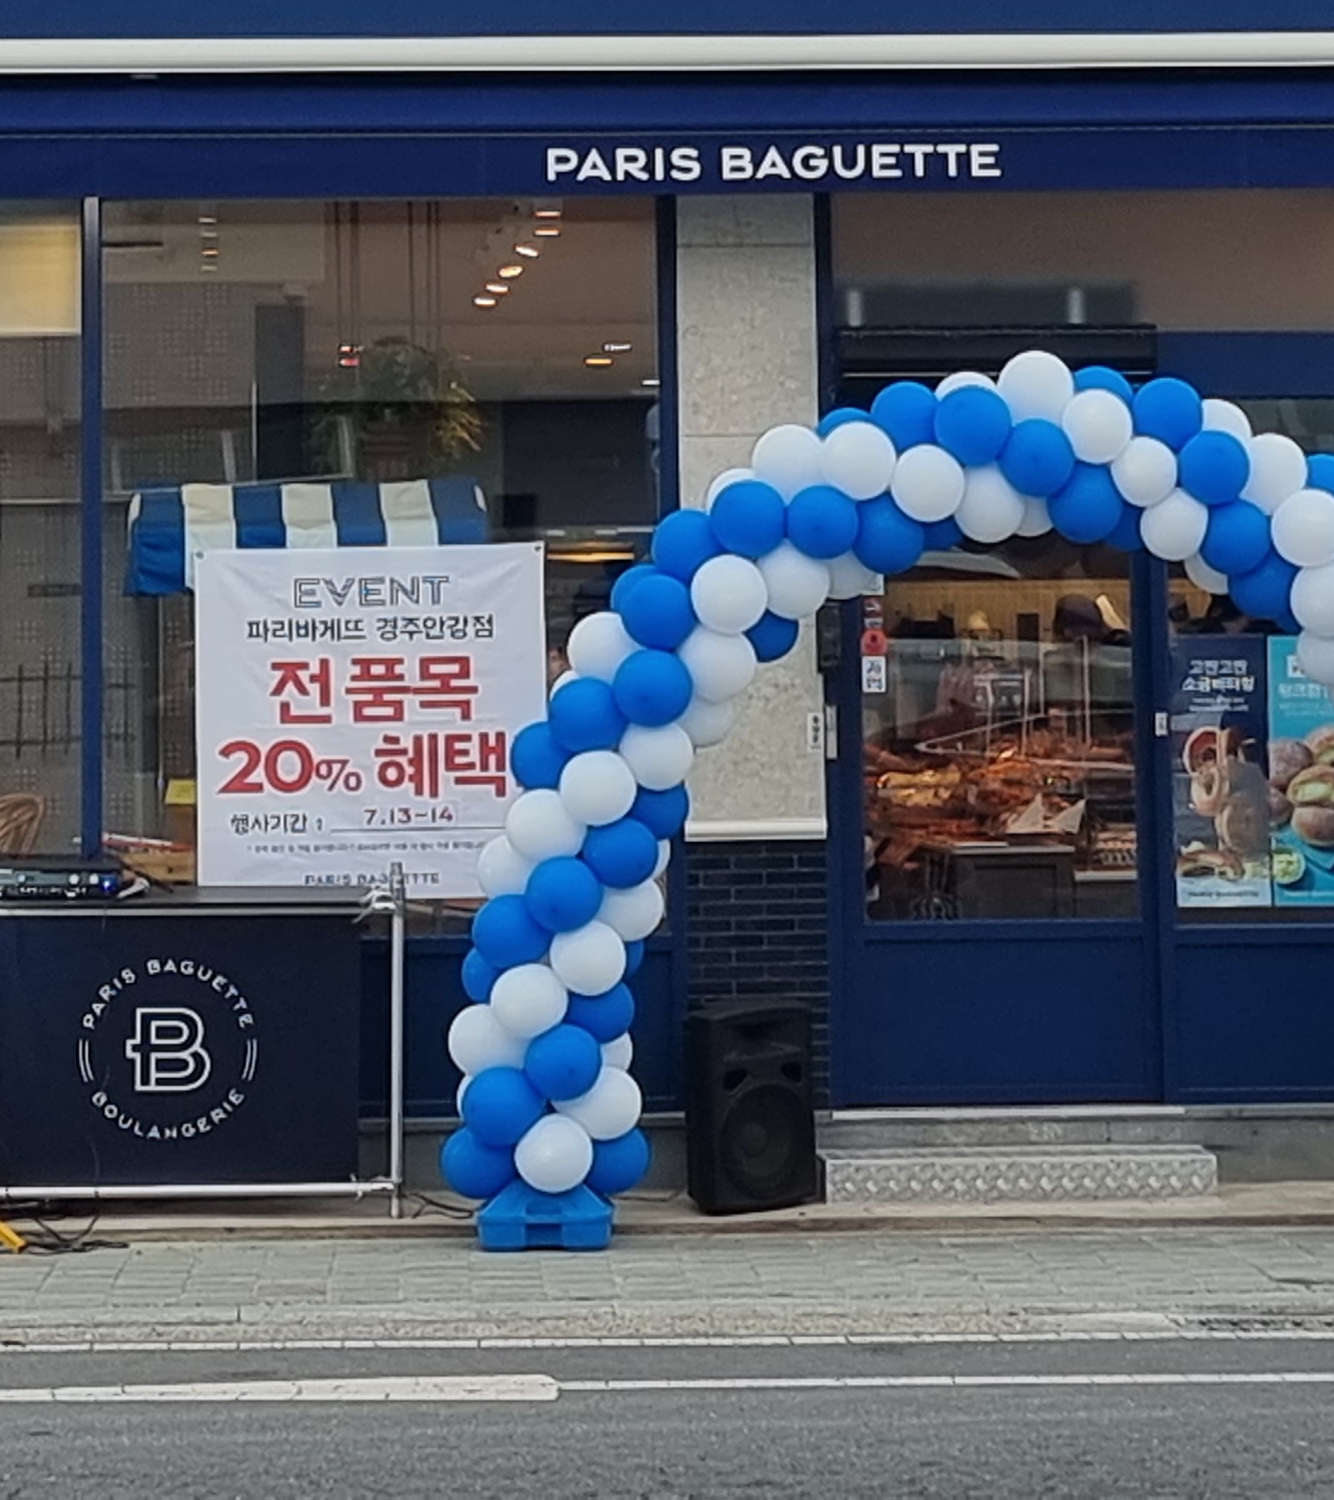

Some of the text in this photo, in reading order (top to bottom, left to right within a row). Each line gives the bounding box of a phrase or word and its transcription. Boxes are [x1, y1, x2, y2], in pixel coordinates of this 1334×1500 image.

[546, 143, 1002, 181] PARIS BAGUETTE
[293, 576, 450, 609] EVENT
[246, 614, 494, 643] 파리바게뜨 경주안강점
[217, 730, 507, 799] 20% 혜택
[230, 813, 308, 835] 행사기간
[82, 958, 255, 1030] PARIS BAGUETTE
[91, 1087, 245, 1140] BOULANGERIE
